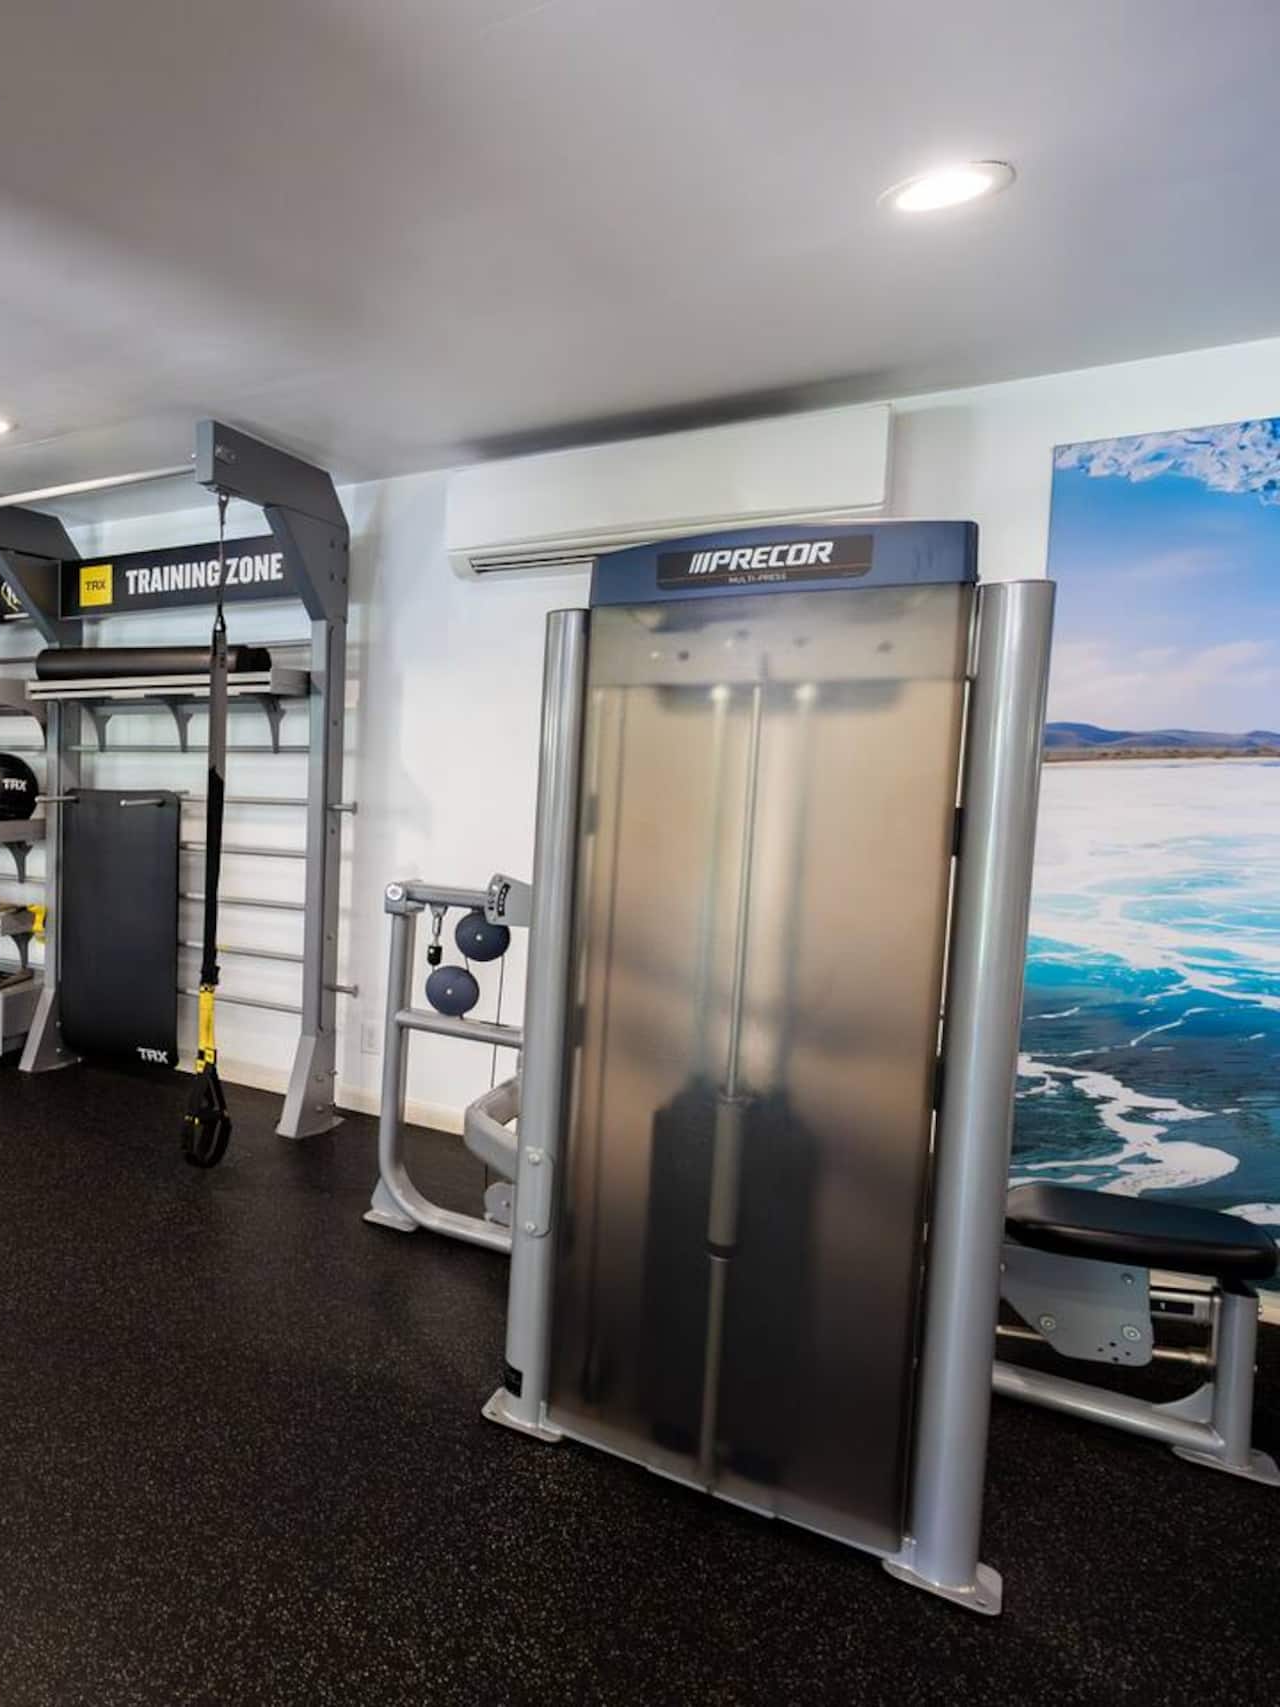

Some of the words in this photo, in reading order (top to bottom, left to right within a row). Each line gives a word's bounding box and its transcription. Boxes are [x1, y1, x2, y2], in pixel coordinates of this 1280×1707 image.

[708, 541, 834, 573] PRECOR
[125, 560, 220, 595] TRAINING
[224, 552, 284, 585] ZONE
[85, 579, 106, 592] TRX
[1, 778, 27, 792] TRX
[136, 1046, 169, 1065] TRX
